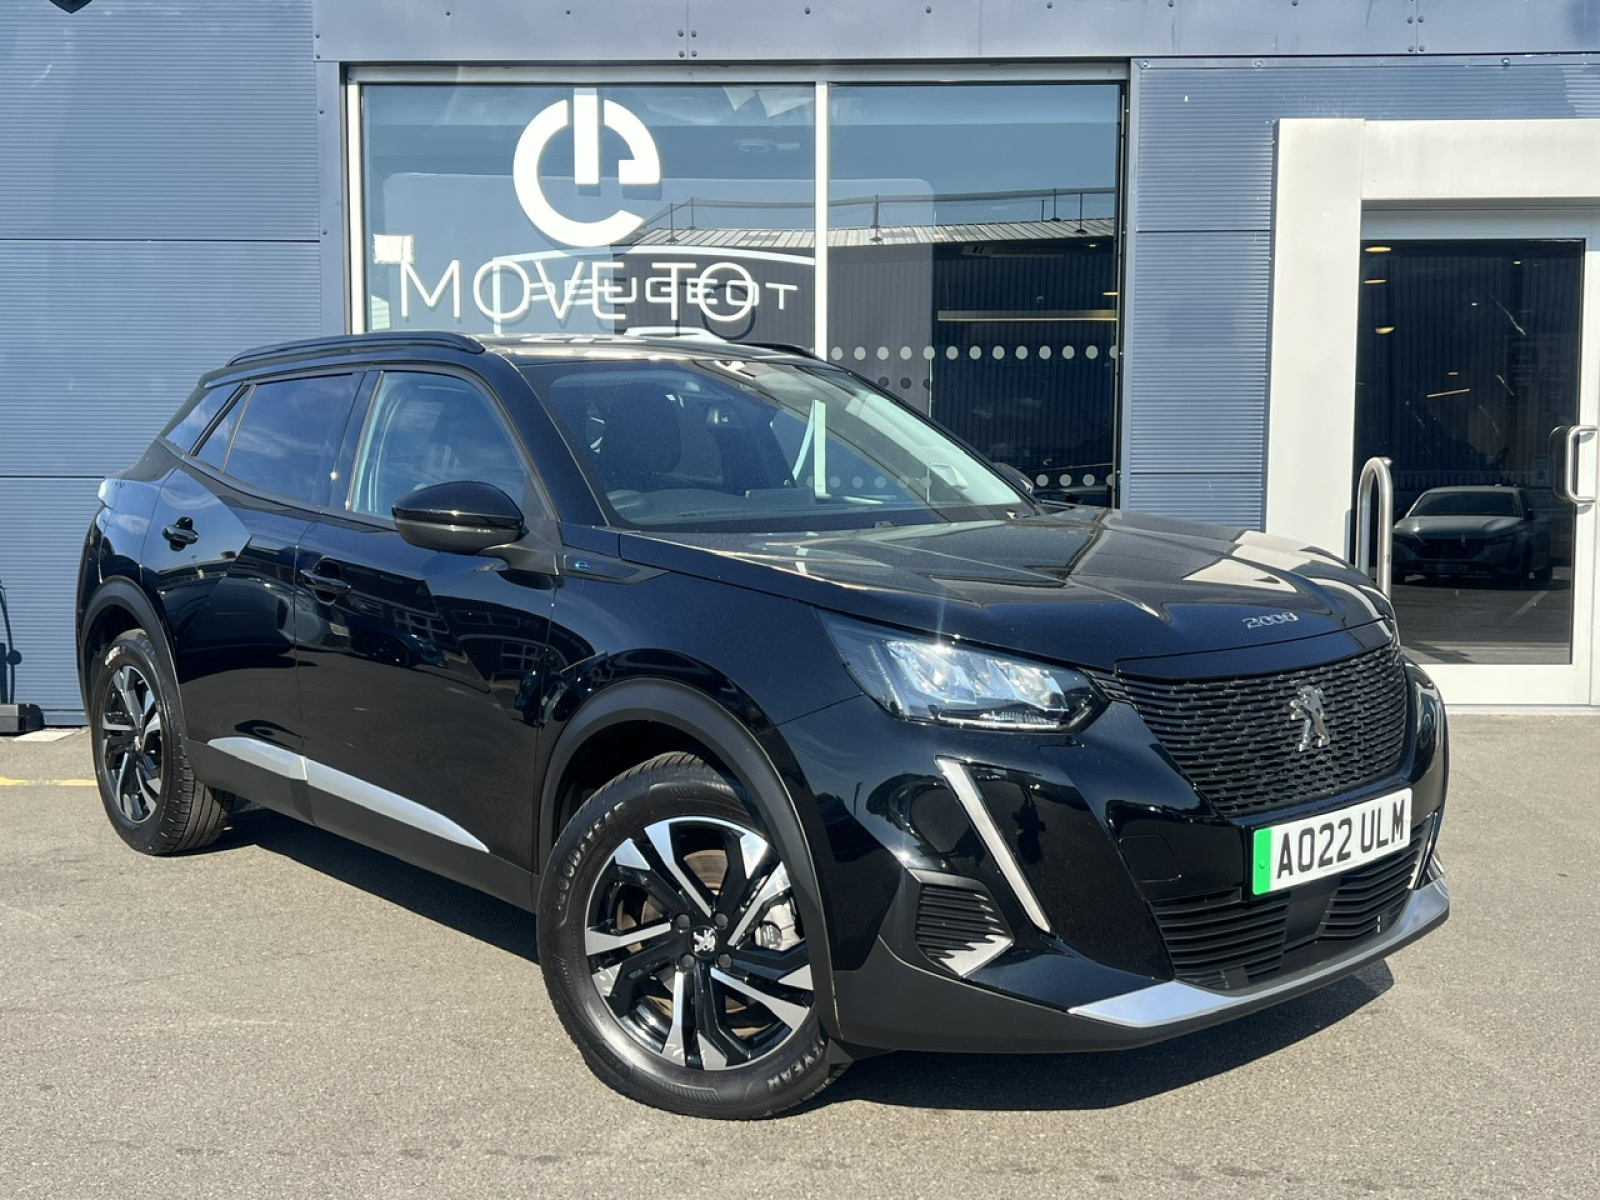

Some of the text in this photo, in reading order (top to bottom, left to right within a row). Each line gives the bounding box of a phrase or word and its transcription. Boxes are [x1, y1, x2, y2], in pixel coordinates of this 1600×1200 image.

[399, 258, 755, 322] MOVE TO
[526, 276, 798, 311] PEUGEOT
[1276, 798, 1406, 880] AO22 ULM
